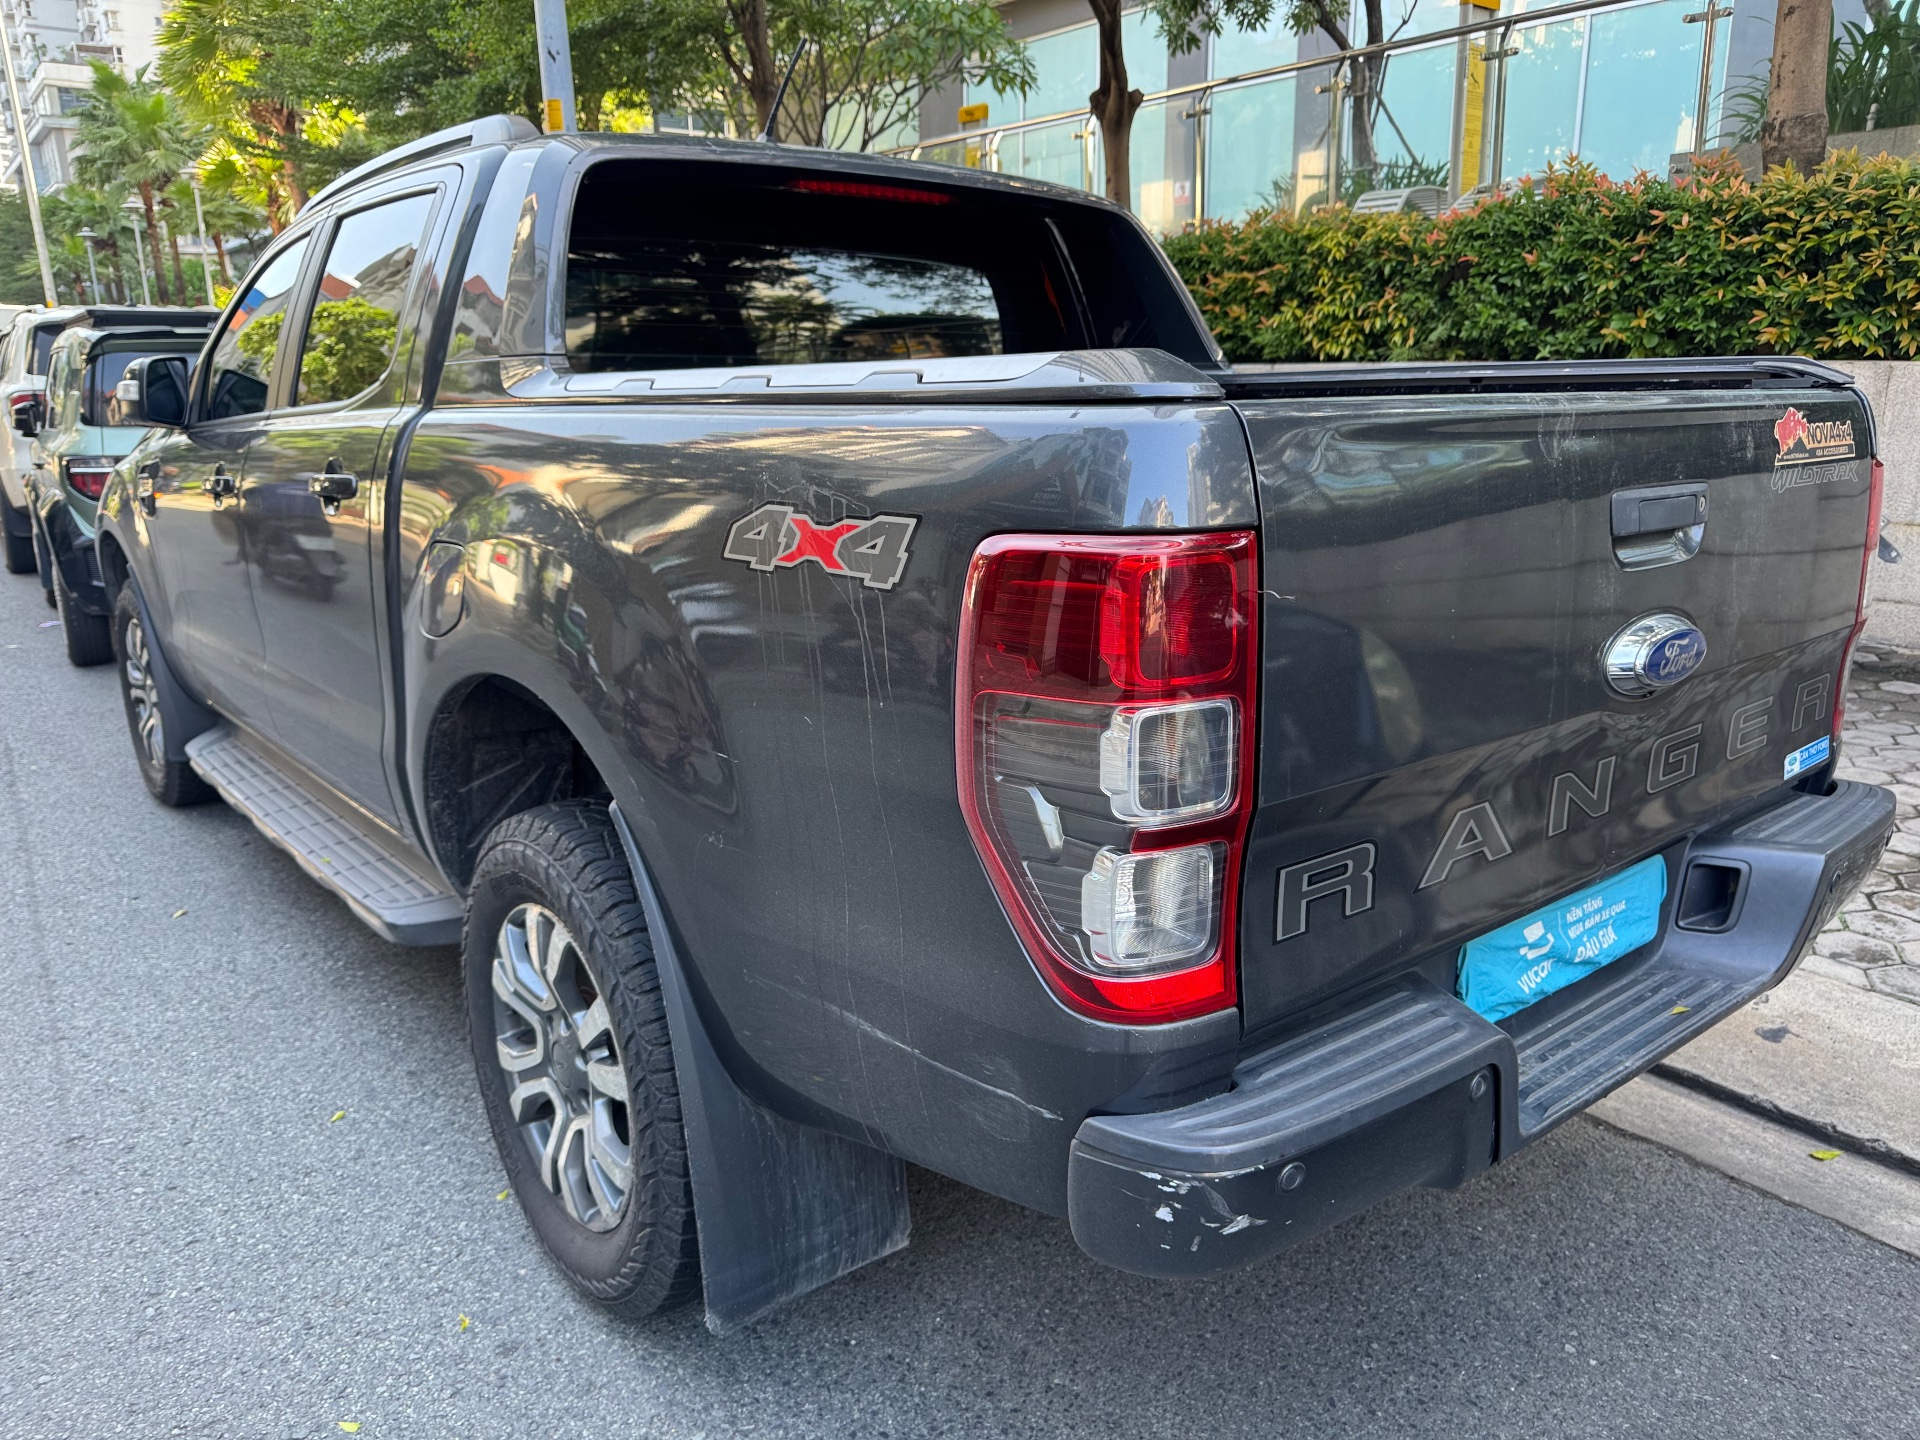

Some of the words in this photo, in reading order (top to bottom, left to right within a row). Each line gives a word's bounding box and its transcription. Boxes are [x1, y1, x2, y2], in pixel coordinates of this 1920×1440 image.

[1771, 460, 1860, 494] WILDTRAK
[1660, 637, 1698, 677] Ford
[1273, 672, 1832, 945] RANGER
[1567, 922, 1585, 940] MUA
[1600, 908, 1611, 922] XE
[1610, 899, 1626, 917] QUA
[1598, 919, 1618, 949] GIÁ
